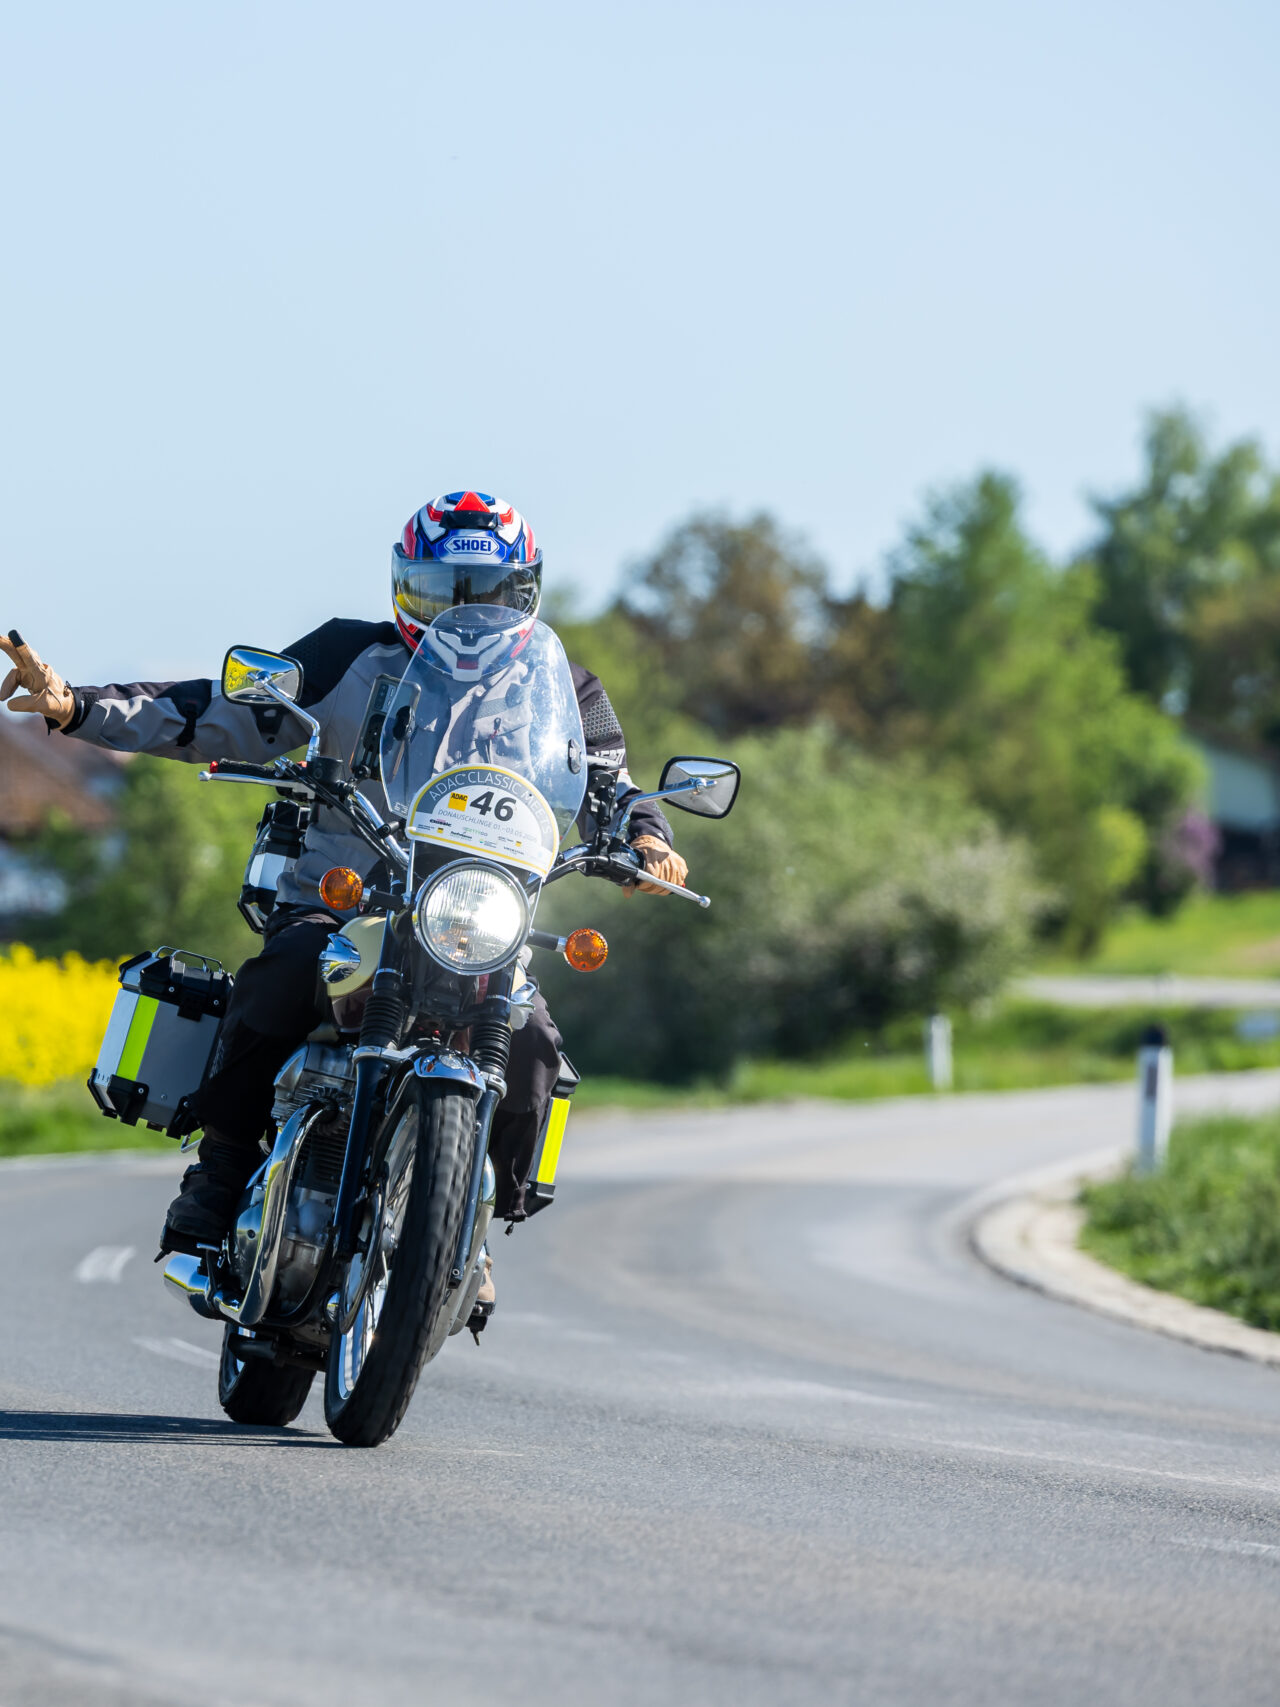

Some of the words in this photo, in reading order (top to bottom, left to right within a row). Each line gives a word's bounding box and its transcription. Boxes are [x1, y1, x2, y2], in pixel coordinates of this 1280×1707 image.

[453, 540, 491, 551] SHOEI
[429, 773, 466, 801] ADAC
[467, 771, 522, 794] CLASSIC
[520, 791, 552, 833] MEETS
[451, 793, 468, 801] ADAC
[469, 790, 517, 822] 46
[438, 809, 492, 828] DONAUSCHLINGE
